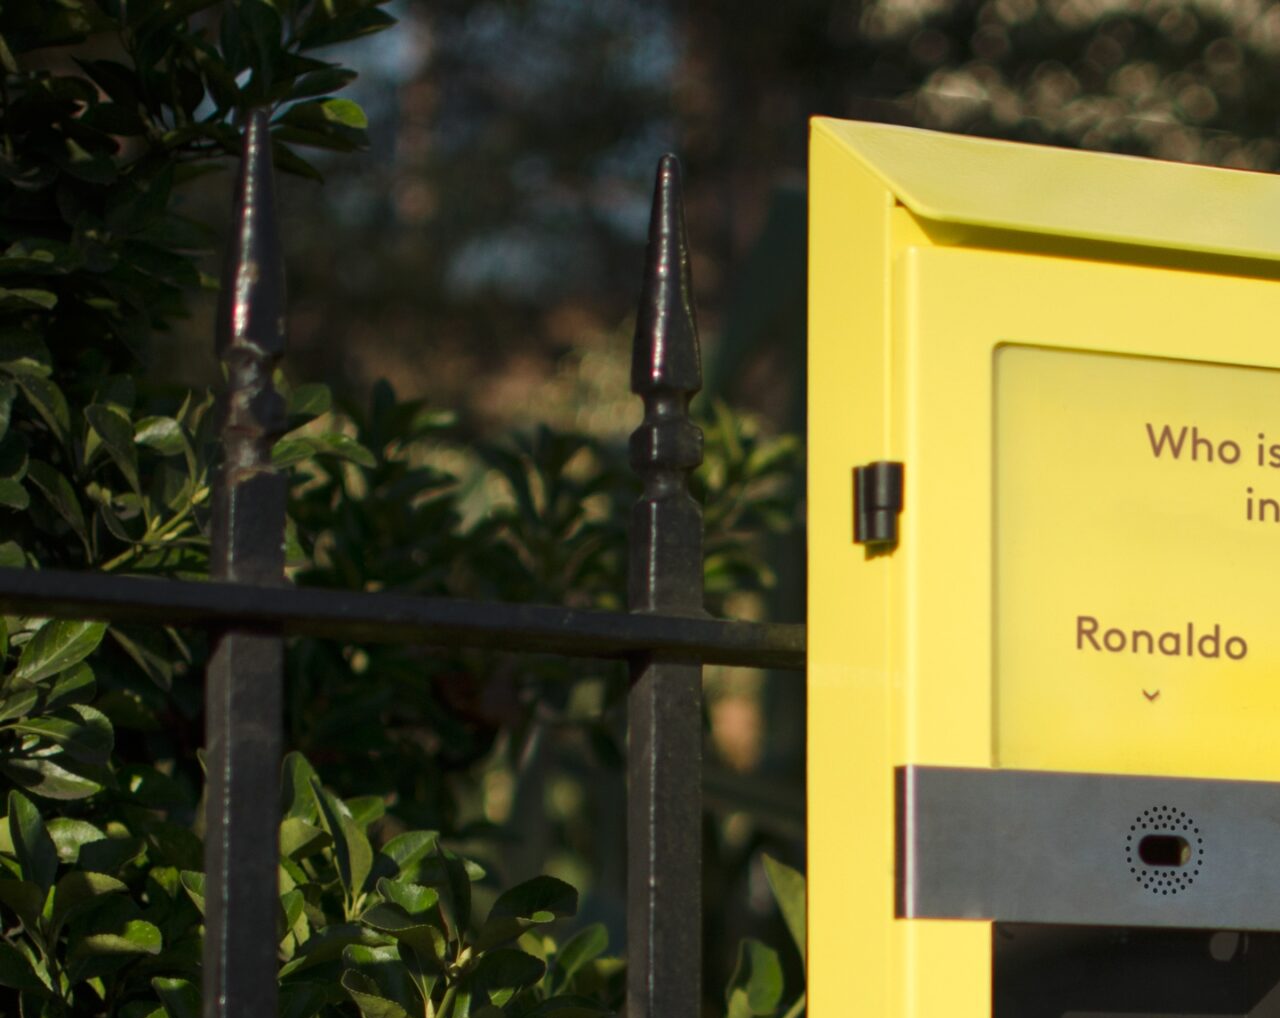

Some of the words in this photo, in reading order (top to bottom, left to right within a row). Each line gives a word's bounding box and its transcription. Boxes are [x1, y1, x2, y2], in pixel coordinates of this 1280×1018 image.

[1145, 422, 1242, 466] Who
[1246, 486, 1280, 524] in
[1076, 615, 1249, 661] Ronaldo
